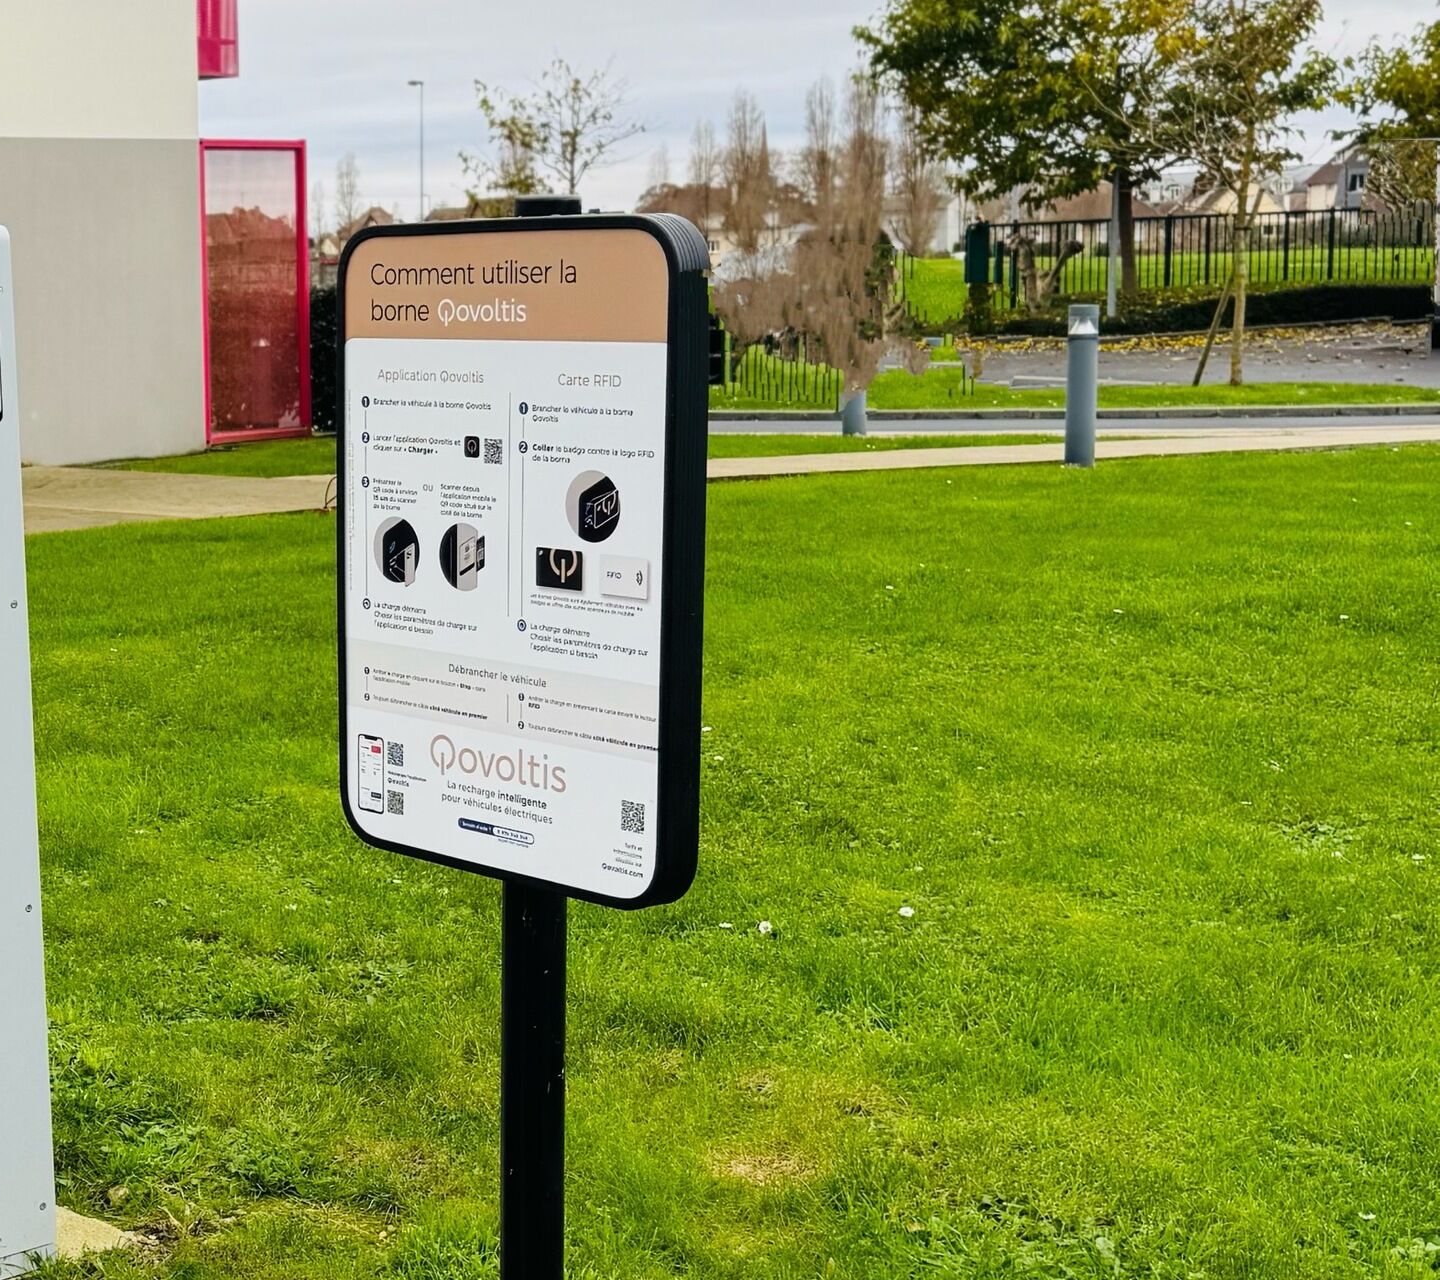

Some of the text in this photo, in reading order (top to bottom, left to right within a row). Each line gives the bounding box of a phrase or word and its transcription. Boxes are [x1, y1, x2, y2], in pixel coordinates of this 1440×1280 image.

[370, 259, 577, 286] Comment utiliser la
[371, 298, 526, 326] borne Qovoltis
[378, 369, 484, 383] Application Qovoltis
[558, 373, 622, 387] Carte RFID
[532, 444, 554, 452] Coller
[423, 484, 433, 492] OU
[448, 663, 547, 688] Débrancher le véhicule
[430, 734, 567, 793] Qovoltis
[447, 780, 547, 809] La recharge intelligente
[441, 793, 553, 825] pour véhicules électriques
